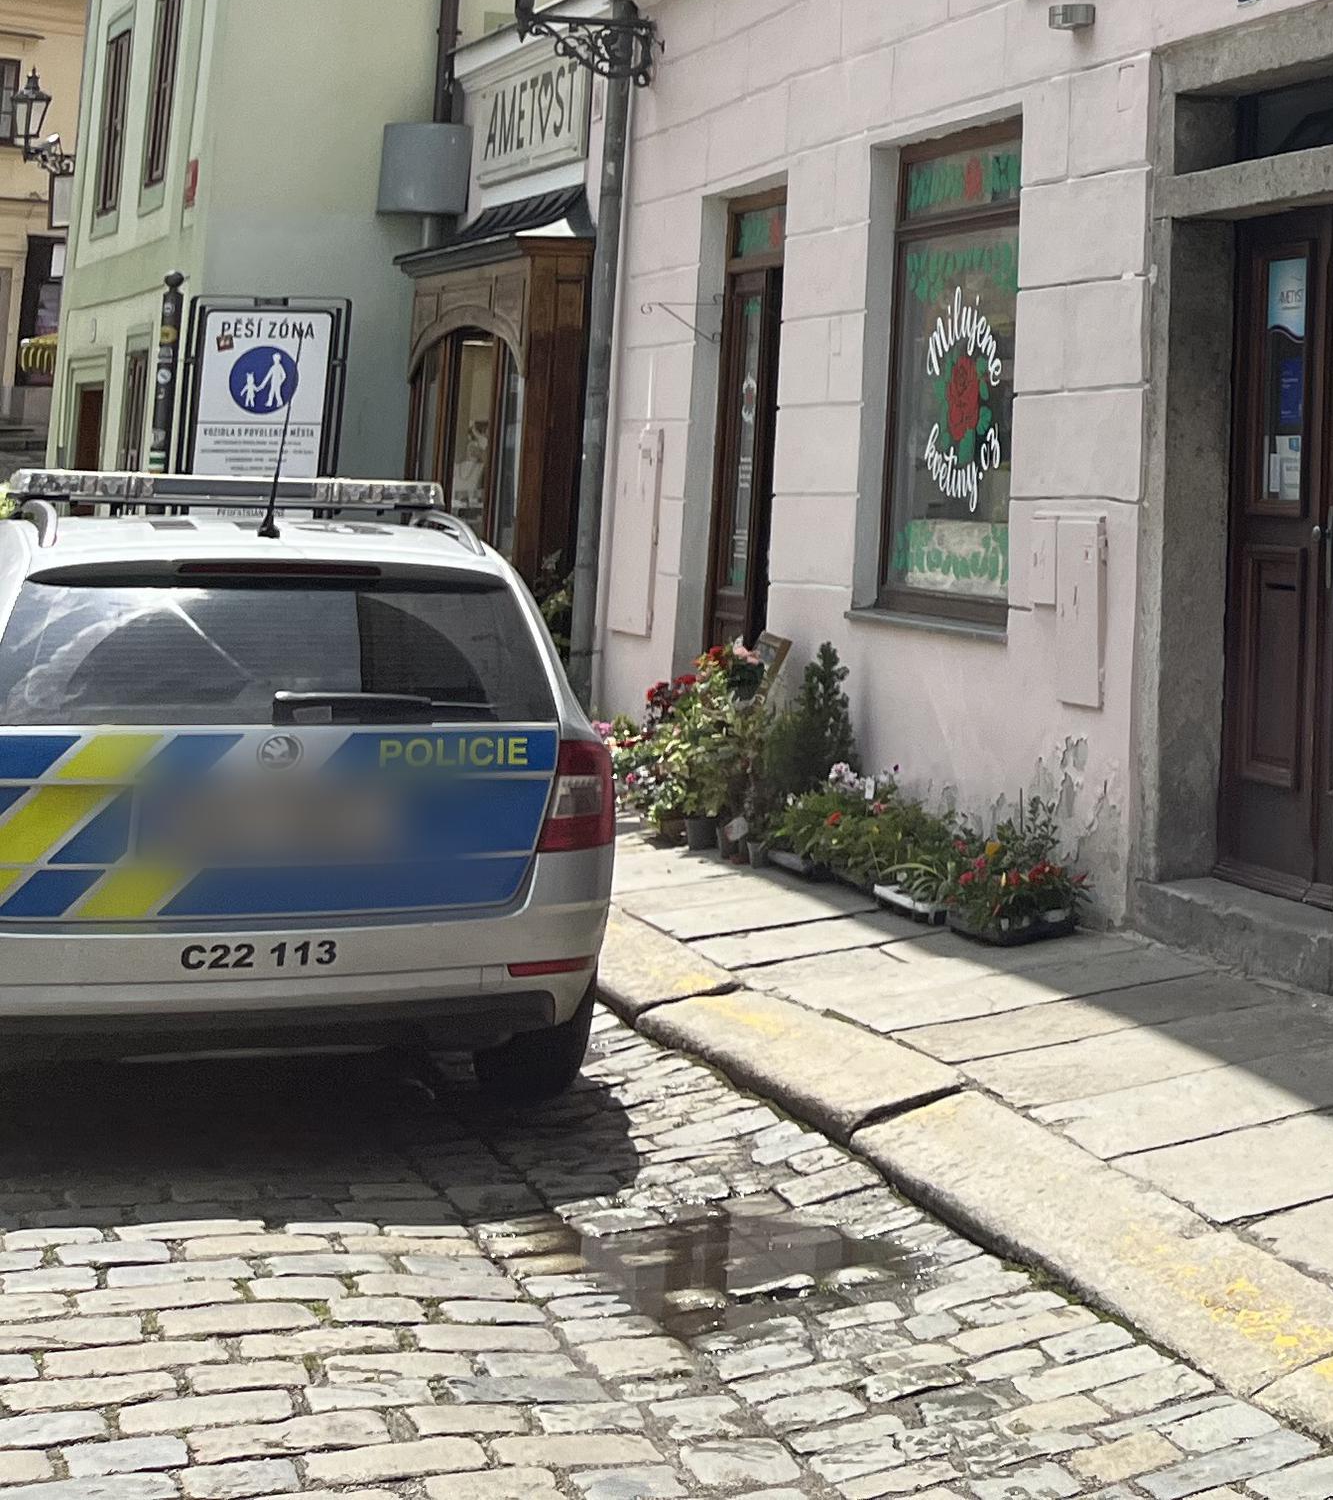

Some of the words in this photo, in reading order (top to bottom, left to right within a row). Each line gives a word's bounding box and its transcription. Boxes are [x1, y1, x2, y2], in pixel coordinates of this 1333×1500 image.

[221, 317, 262, 339] PĚŠÍ
[268, 318, 315, 340] ZÓNA
[379, 736, 529, 768] POLICIE
[181, 943, 255, 971] C22
[270, 940, 337, 967] 113
